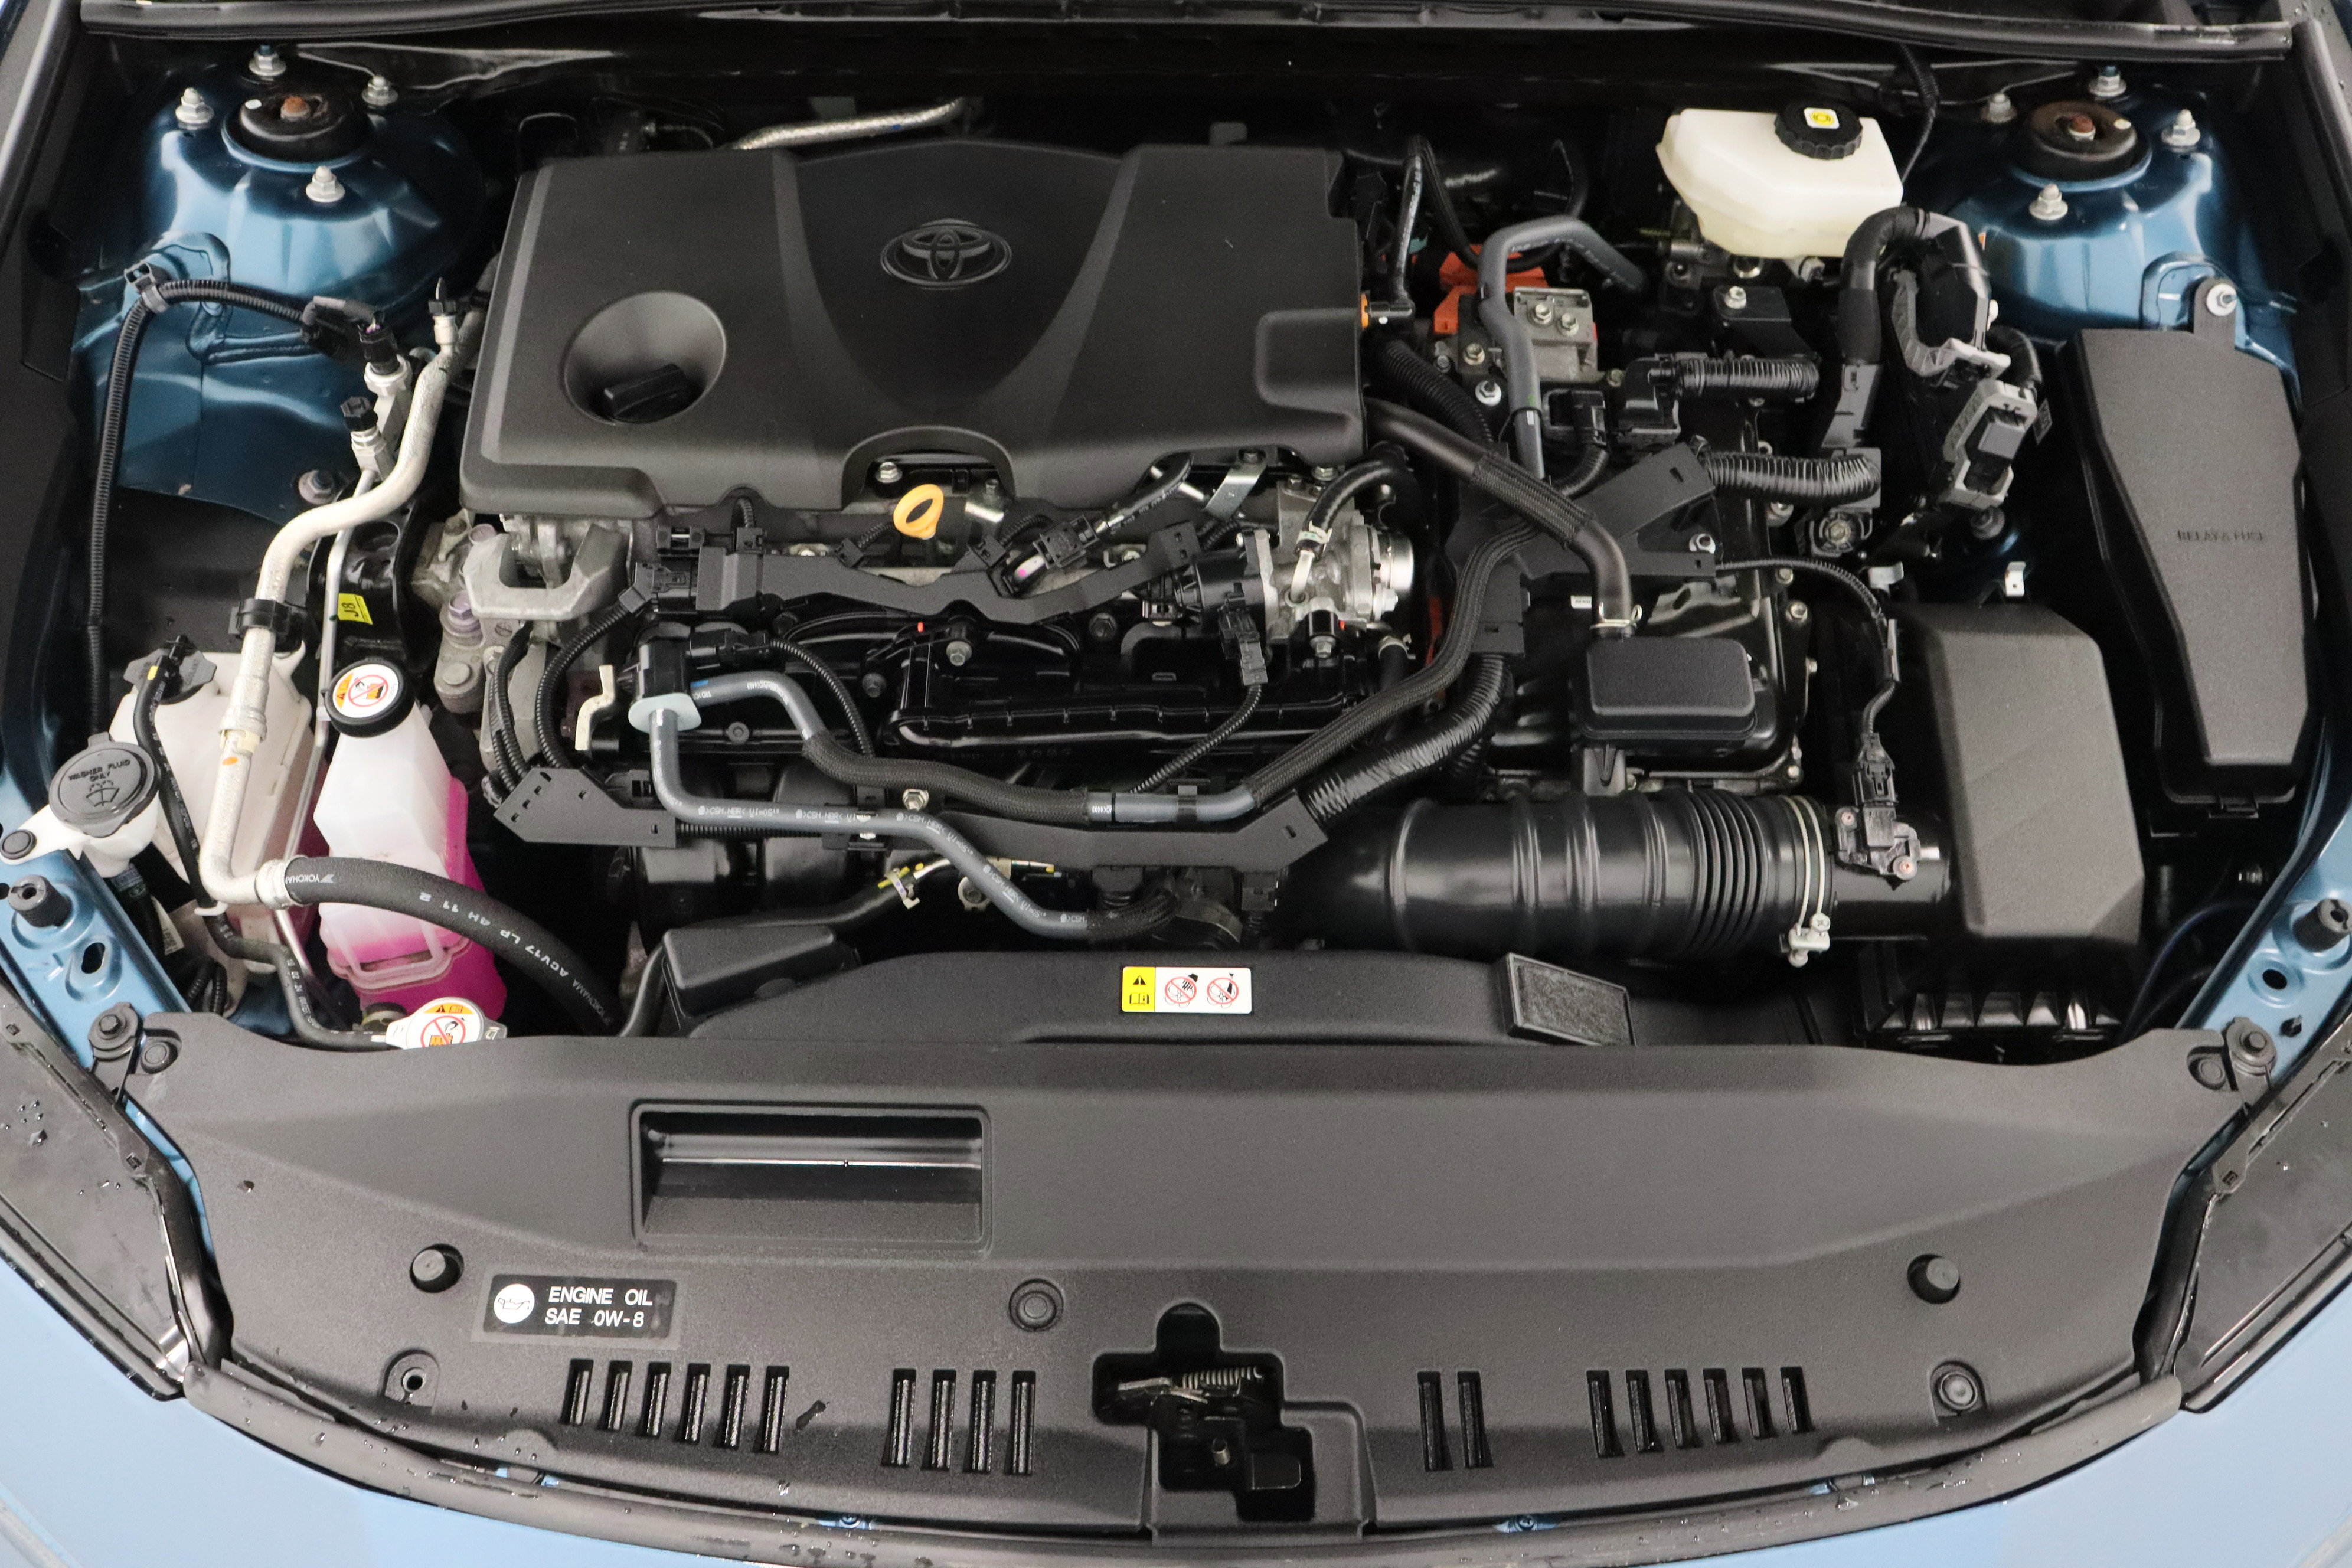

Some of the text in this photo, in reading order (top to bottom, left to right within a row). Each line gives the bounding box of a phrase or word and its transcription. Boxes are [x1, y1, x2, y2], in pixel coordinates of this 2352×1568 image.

[468, 911, 491, 926] 4H
[499, 929, 520, 944] LP
[525, 945, 569, 977] ACV17
[573, 979, 605, 1017] YOKOHAMA
[548, 1286, 653, 1306] ENGINE OIL
[545, 1308, 645, 1328] SAE 0W-8
